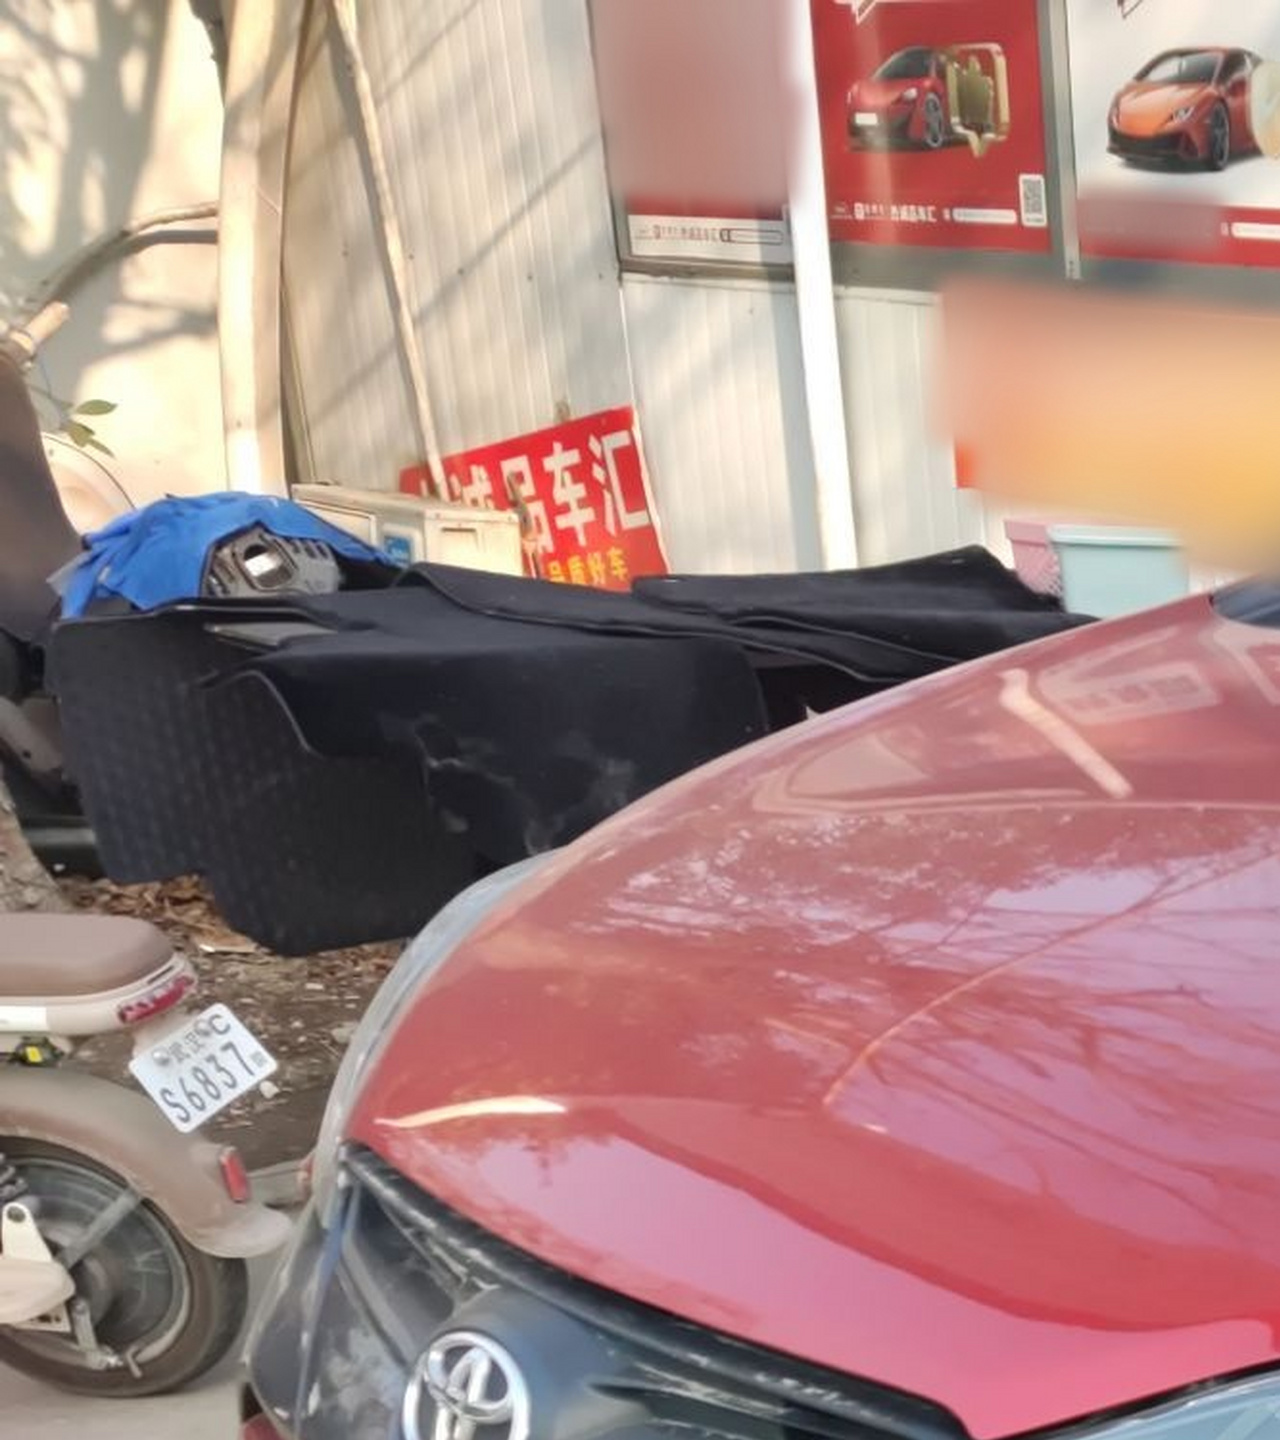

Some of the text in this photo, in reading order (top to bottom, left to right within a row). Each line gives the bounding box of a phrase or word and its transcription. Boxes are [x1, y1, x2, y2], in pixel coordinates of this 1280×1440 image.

[420, 430, 652, 552] 品车汇
[159, 1040, 255, 1124] S6837
